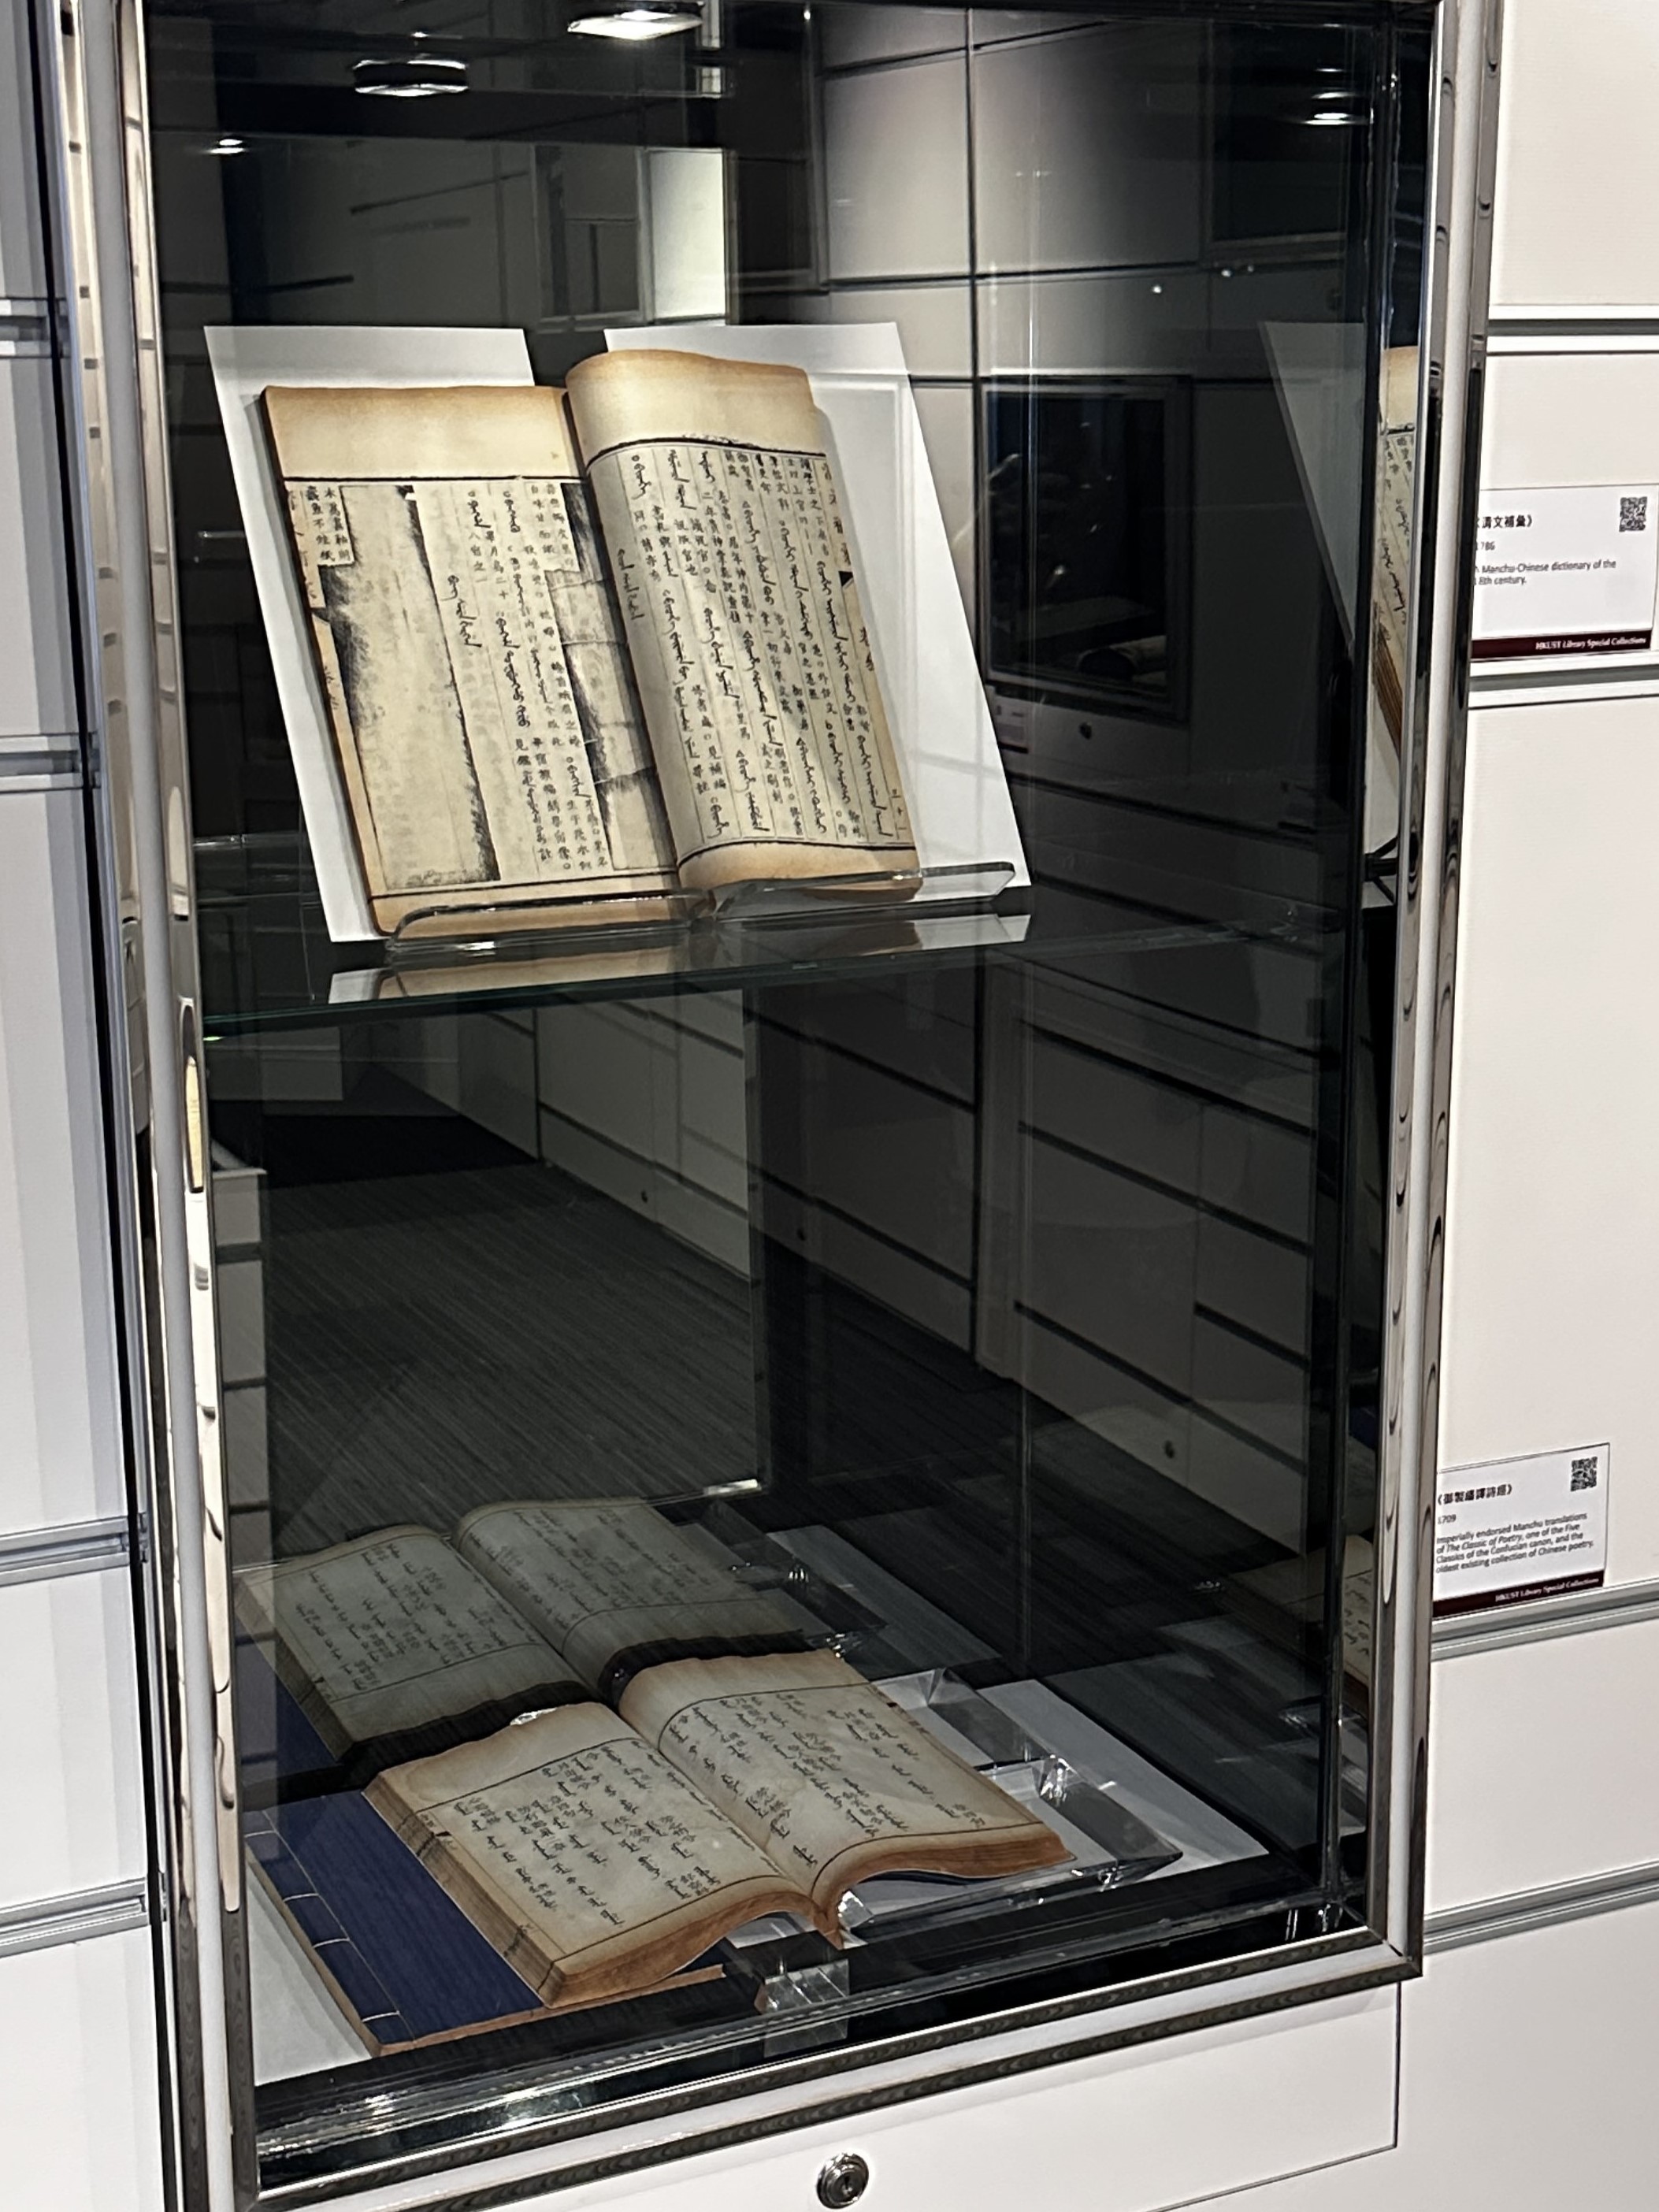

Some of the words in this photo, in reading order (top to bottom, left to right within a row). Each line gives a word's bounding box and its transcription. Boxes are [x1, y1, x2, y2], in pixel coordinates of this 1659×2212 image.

[1482, 562, 1549, 573] Manchu-Chinese
[1551, 561, 1590, 570] dictionary
[1593, 559, 1601, 569] of
[1603, 559, 1616, 568] the
[1535, 640, 1561, 650] HKUST
[1562, 640, 1585, 649] Library
[1587, 638, 1610, 648] Special
[1611, 637, 1646, 646] Collections
[1437, 1531, 1474, 1544] Imperially
[1476, 1525, 1512, 1538] endorsed
[1513, 1520, 1543, 1531] Manchu
[1545, 1512, 1587, 1526] translations
[1438, 1514, 1457, 1524] 1709
[1436, 1546, 1445, 1554] of
[1447, 1543, 1460, 1553] The
[1461, 1540, 1486, 1550] Classic
[1489, 1537, 1498, 1546] of
[1542, 1527, 1550, 1536] of
[1550, 1526, 1564, 1535] the
[1436, 1553, 1464, 1564] Classics
[1466, 1550, 1475, 1559] of
[1490, 1542, 1527, 1554] Confucian
[1529, 1538, 1553, 1548] canon,
[1436, 1564, 1459, 1573] oldest
[1460, 1559, 1490, 1569] existing
[1491, 1551, 1527, 1564] collection
[1528, 1549, 1537, 1557] of
[1538, 1544, 1567, 1556] Chinese
[1520, 1587, 1542, 1598] Library
[1543, 1583, 1564, 1593] Special
[1566, 1578, 1599, 1589] Collections
